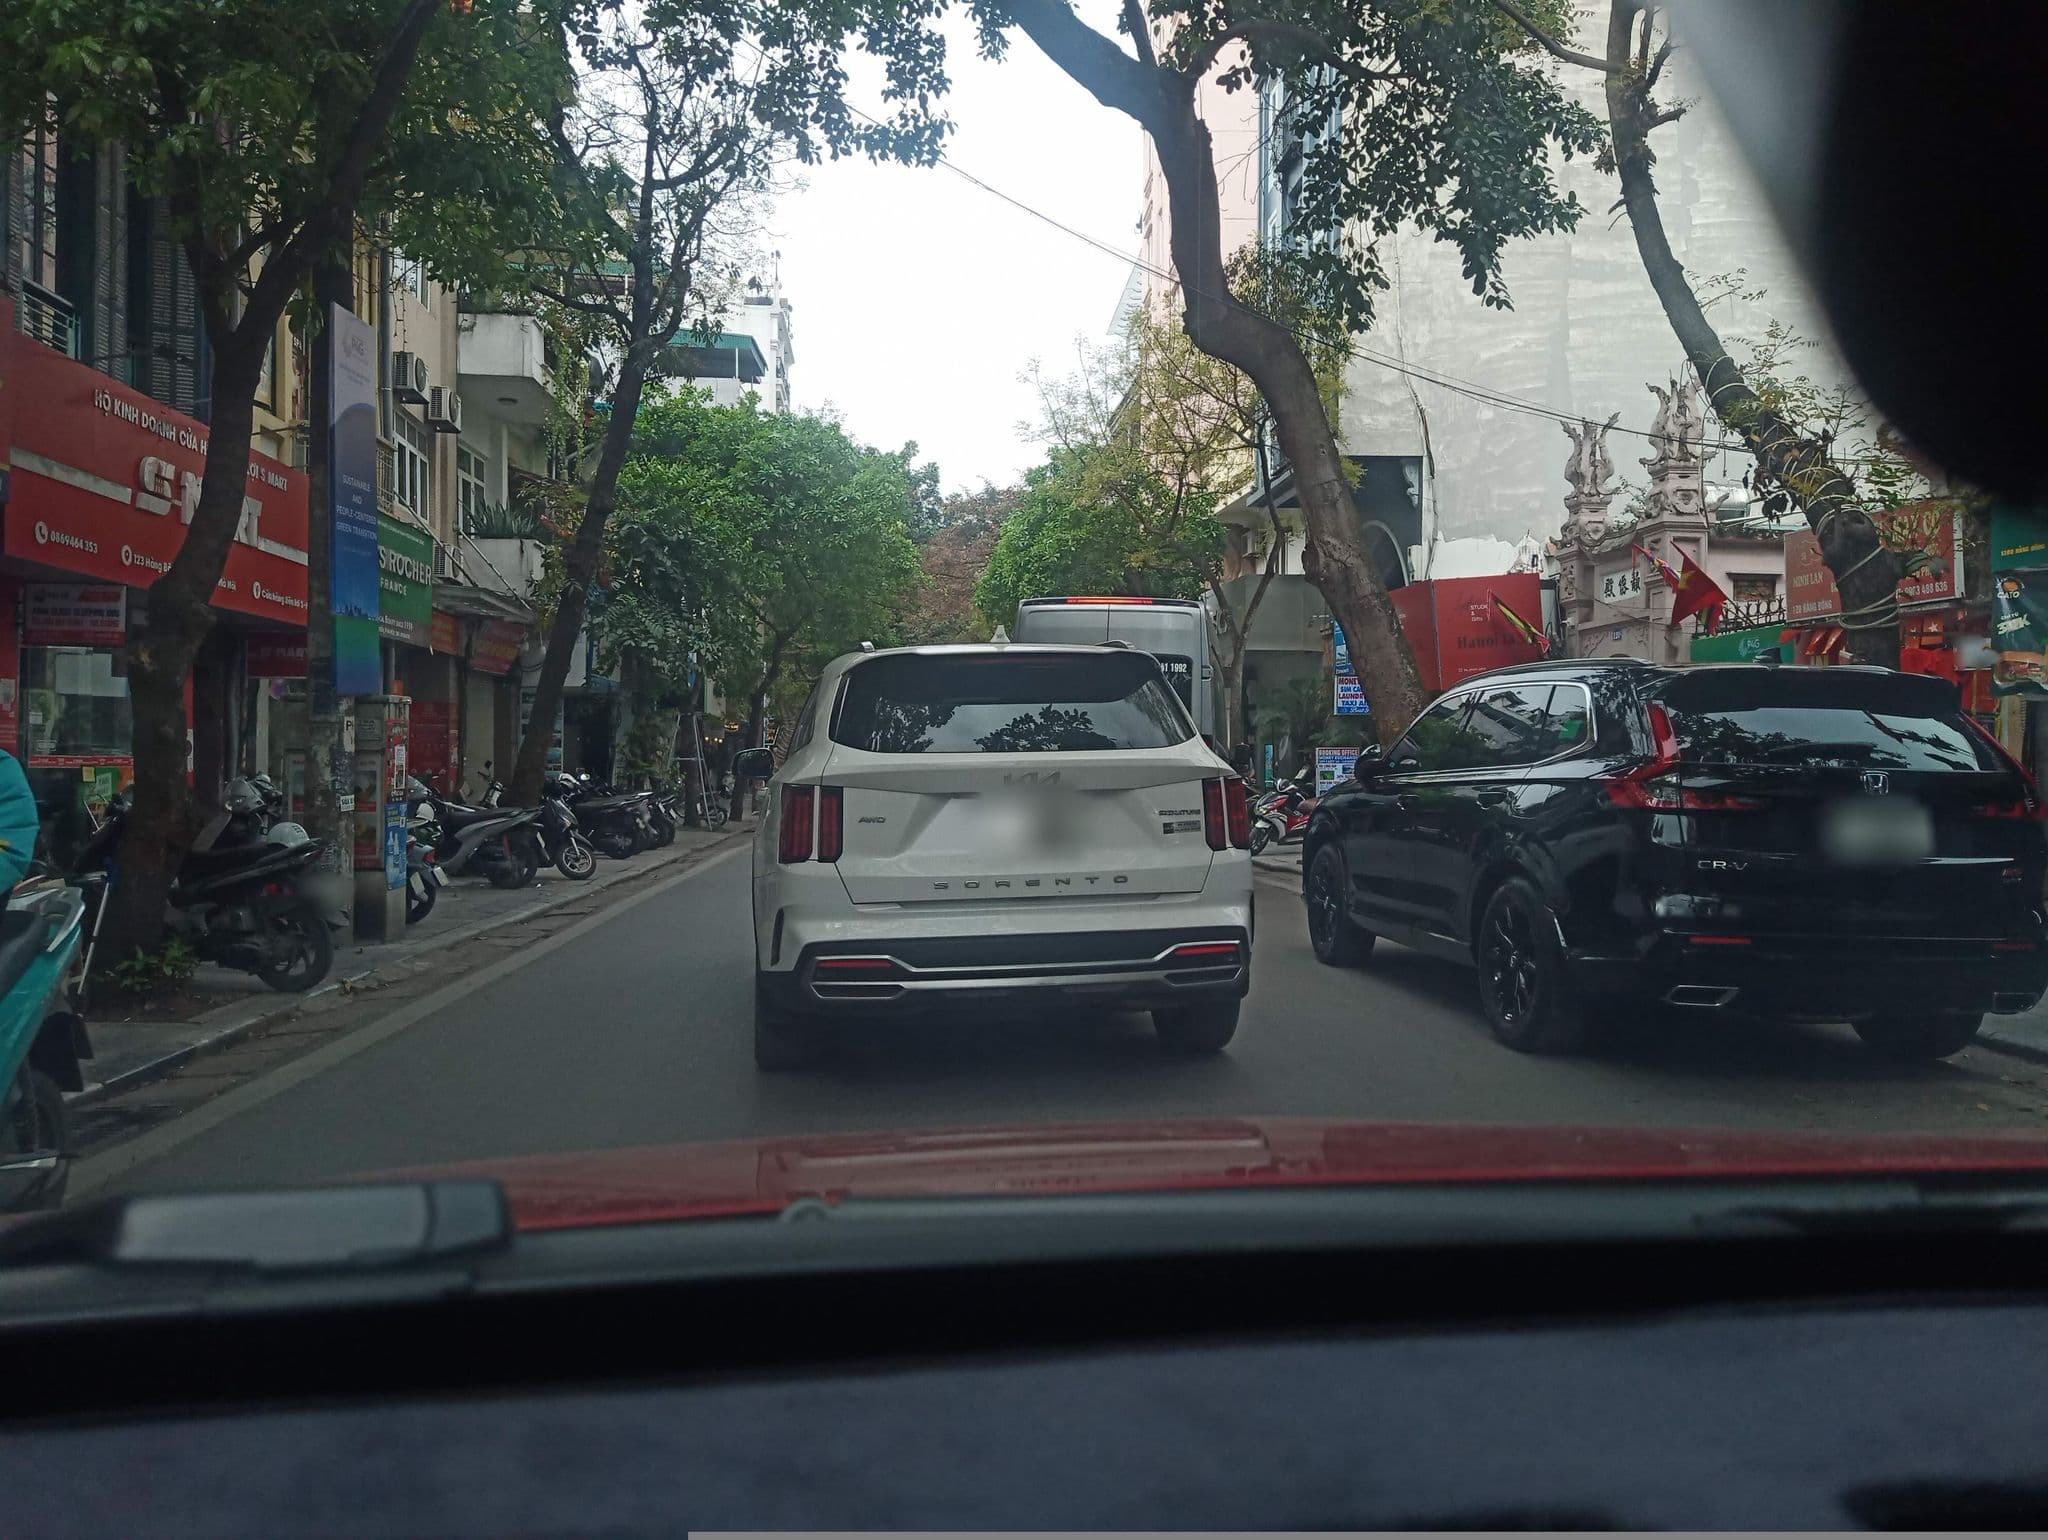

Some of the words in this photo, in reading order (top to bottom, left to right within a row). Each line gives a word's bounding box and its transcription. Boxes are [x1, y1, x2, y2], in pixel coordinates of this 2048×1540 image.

[114, 399, 140, 425] KINH
[142, 412, 176, 441] DOANH
[267, 471, 289, 492] MART
[133, 553, 145, 567] 123
[388, 549, 432, 587] ROCHER
[380, 577, 408, 597] FRANCE
[1997, 590, 2020, 599] CATO
[1170, 662, 1188, 674] 1992
[1338, 692, 1366, 700] LAUNDR
[1341, 748, 1359, 756] OFFICE
[858, 815, 887, 825] AWD
[932, 874, 1129, 890] SORENTO
